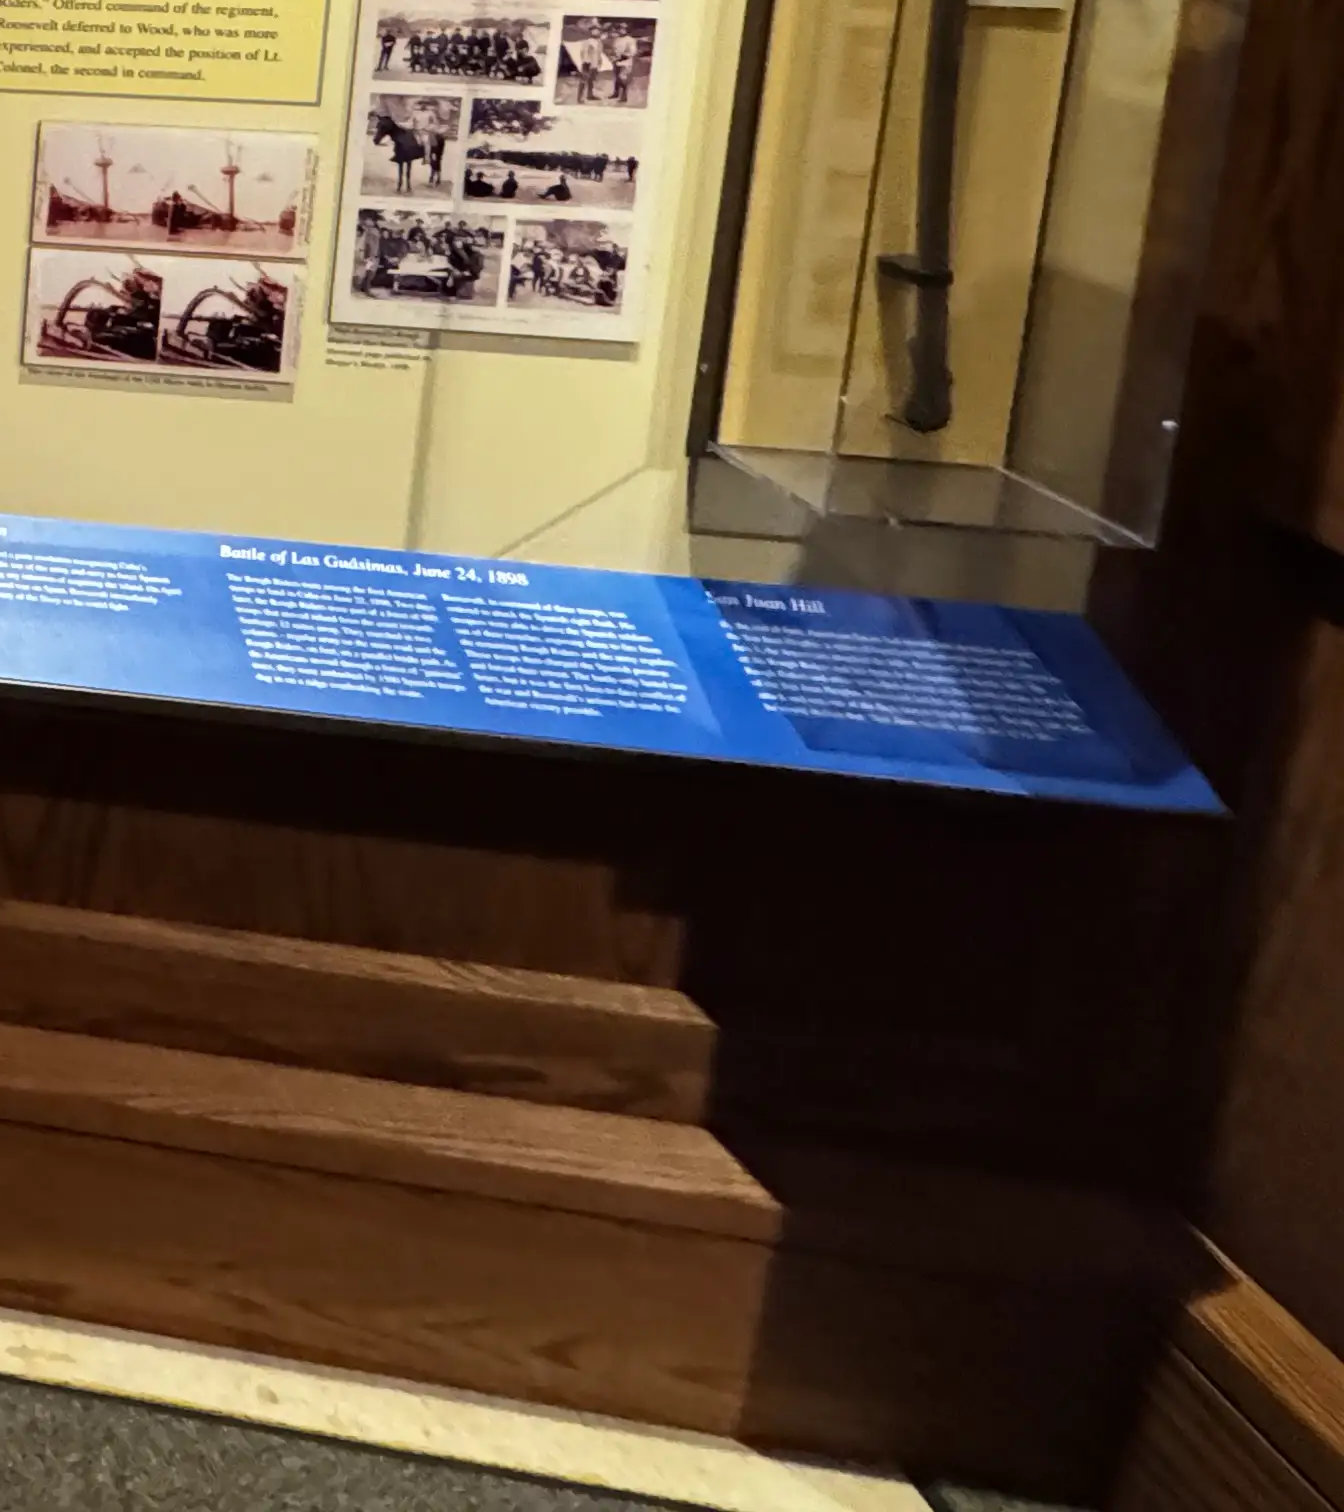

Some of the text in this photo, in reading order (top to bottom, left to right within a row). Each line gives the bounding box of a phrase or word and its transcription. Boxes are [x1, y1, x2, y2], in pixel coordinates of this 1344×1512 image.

[106, 0, 169, 14] command
[173, 1, 188, 14] of
[192, 2, 212, 15] the
[62, 19, 116, 33] deferred
[119, 22, 132, 34] to
[182, 25, 210, 38] who
[214, 27, 239, 38] was
[244, 28, 278, 39] more
[78, 42, 101, 55] and
[104, 43, 160, 59] accepted
[165, 46, 184, 58] the
[188, 47, 241, 62] position
[245, 48, 260, 61] of
[50, 62, 70, 75] the
[74, 64, 118, 78] second
[122, 66, 134, 79] in
[220, 544, 266, 562] Battle
[270, 550, 289, 566] of
[291, 551, 321, 567] Las
[413, 563, 452, 580] June
[488, 569, 530, 587] 1898
[743, 594, 787, 611] Juan
[789, 596, 828, 615] Hill
